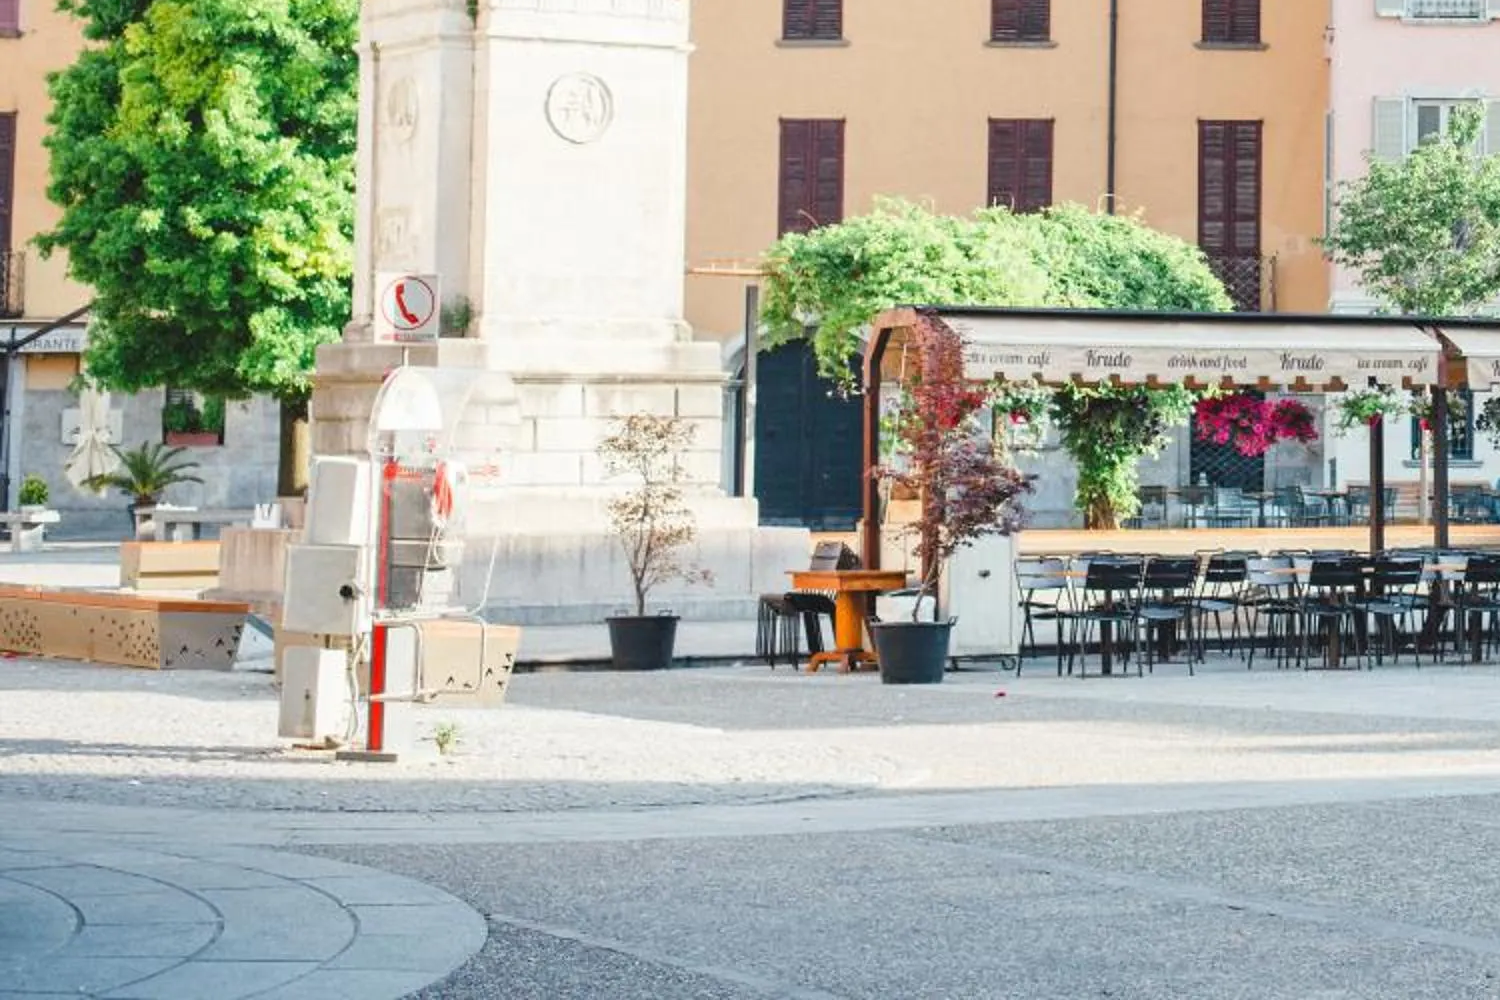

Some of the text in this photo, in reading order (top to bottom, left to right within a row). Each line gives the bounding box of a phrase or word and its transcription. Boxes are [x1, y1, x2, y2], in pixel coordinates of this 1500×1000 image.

[1086, 350, 1132, 369] Krudo
[1167, 353, 1198, 368] drink
[1199, 355, 1221, 369] and
[1222, 354, 1247, 371] food
[1280, 352, 1325, 370] Krudo
[1373, 359, 1403, 369] cream
